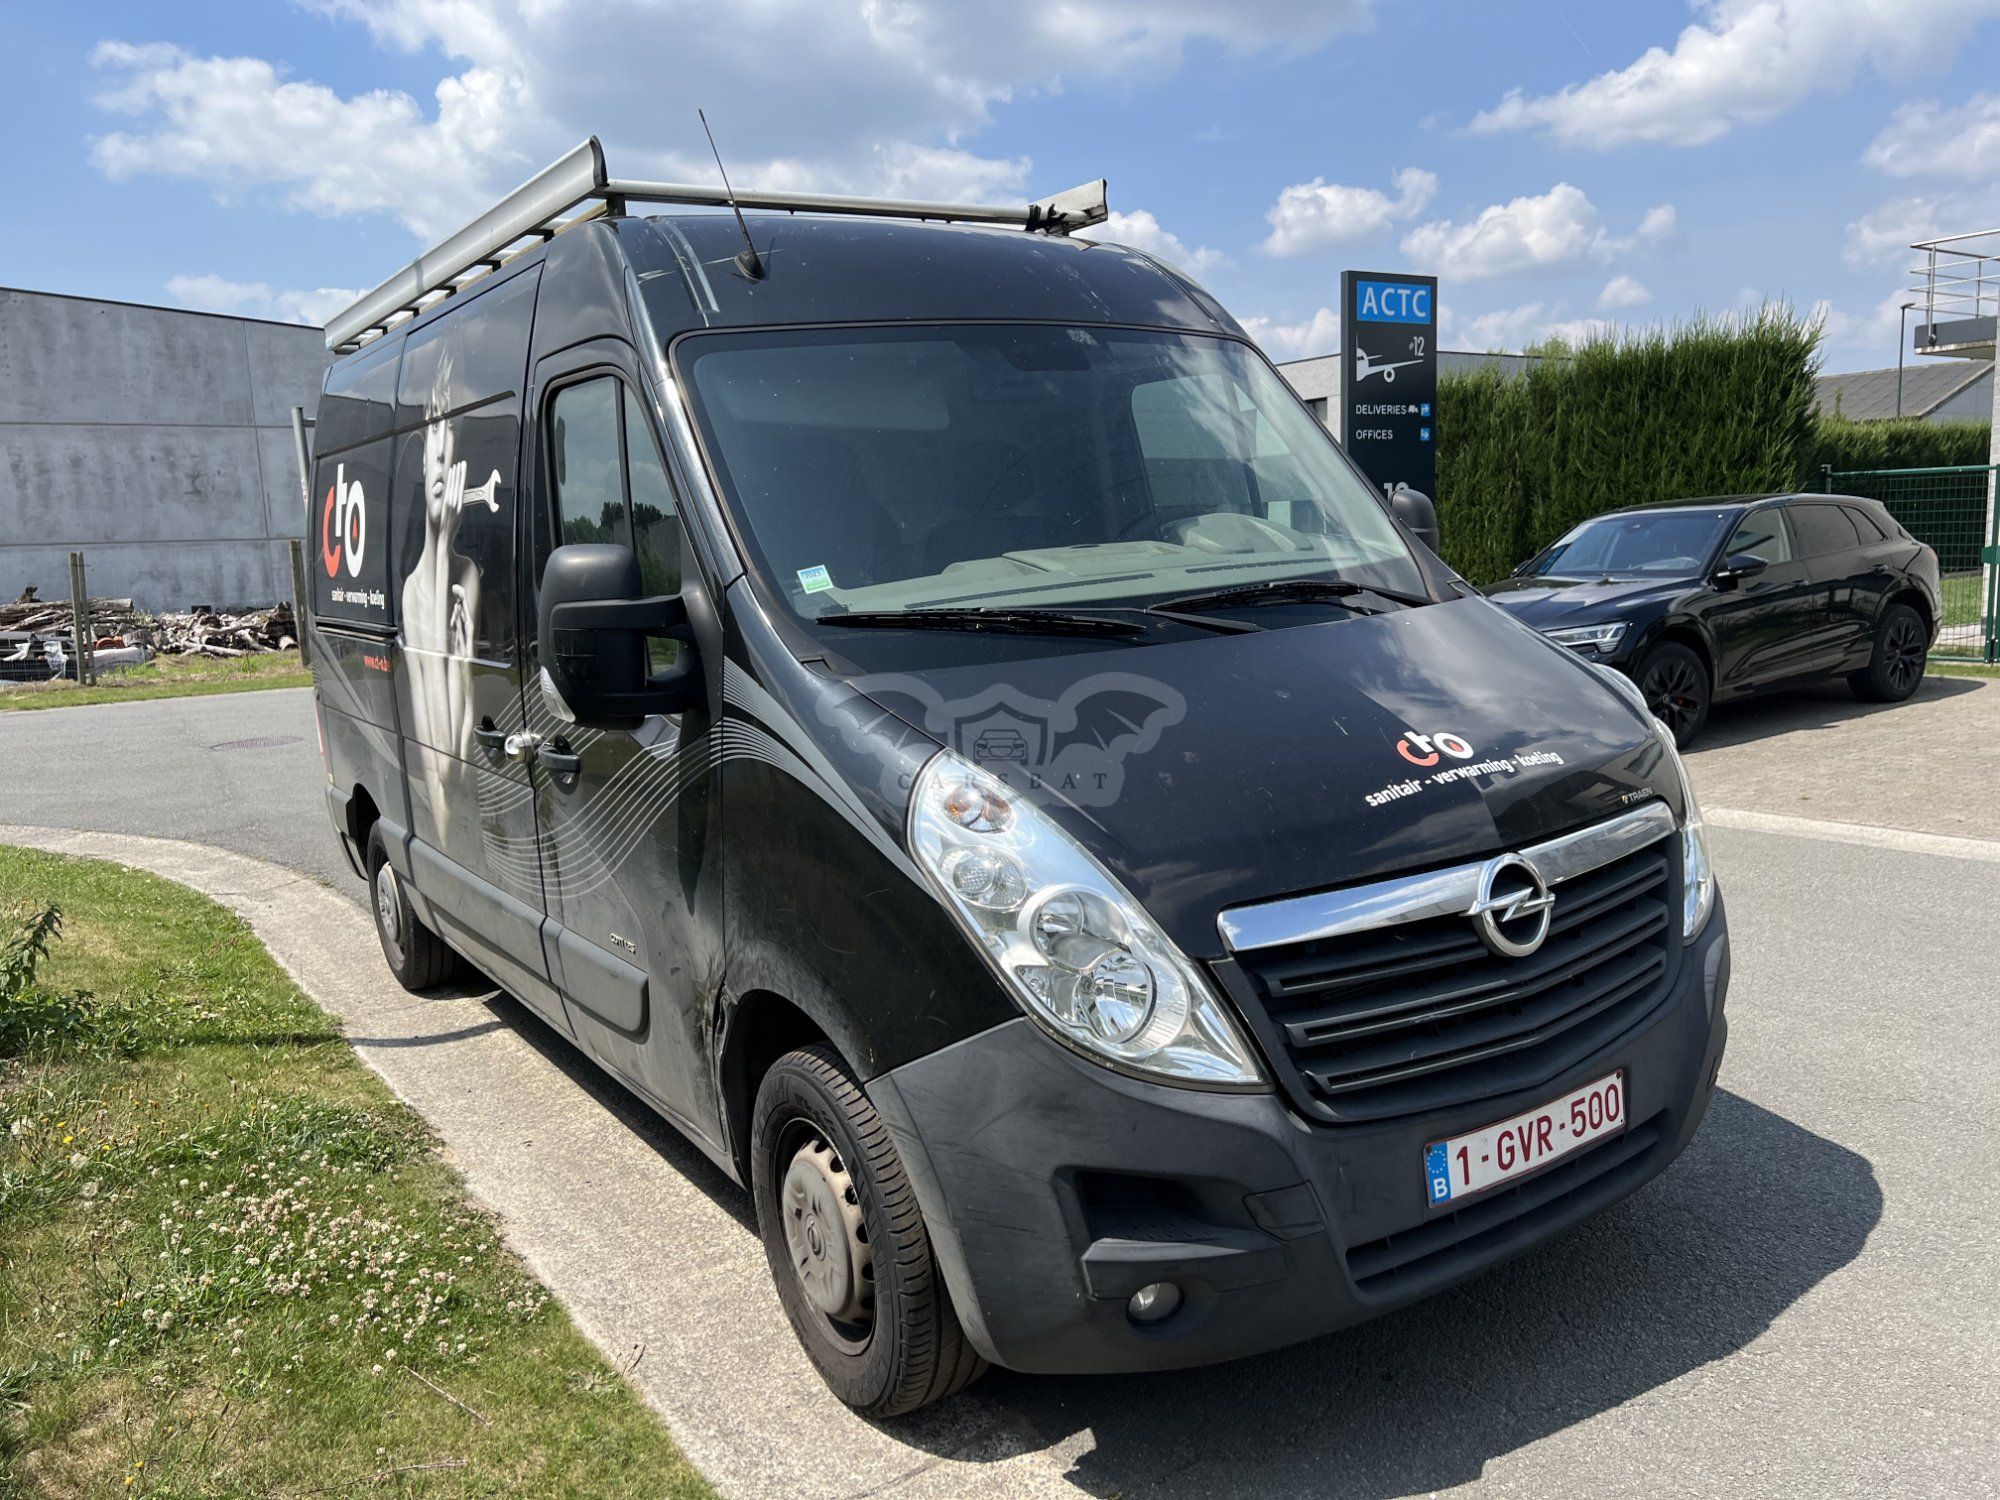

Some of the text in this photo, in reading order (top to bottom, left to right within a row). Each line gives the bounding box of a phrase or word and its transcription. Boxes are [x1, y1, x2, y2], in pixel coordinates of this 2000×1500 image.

[1362, 287, 1427, 318] ACTC
[1355, 404, 1407, 416] DELIVERIES
[1355, 429, 1394, 440] OFFICES
[1365, 778, 1422, 808] sanitair
[1432, 757, 1513, 785] verwarming
[1516, 751, 1564, 766] koeling
[1456, 1083, 1620, 1186] 1-GVR-500
[1433, 1177, 1448, 1199] B
